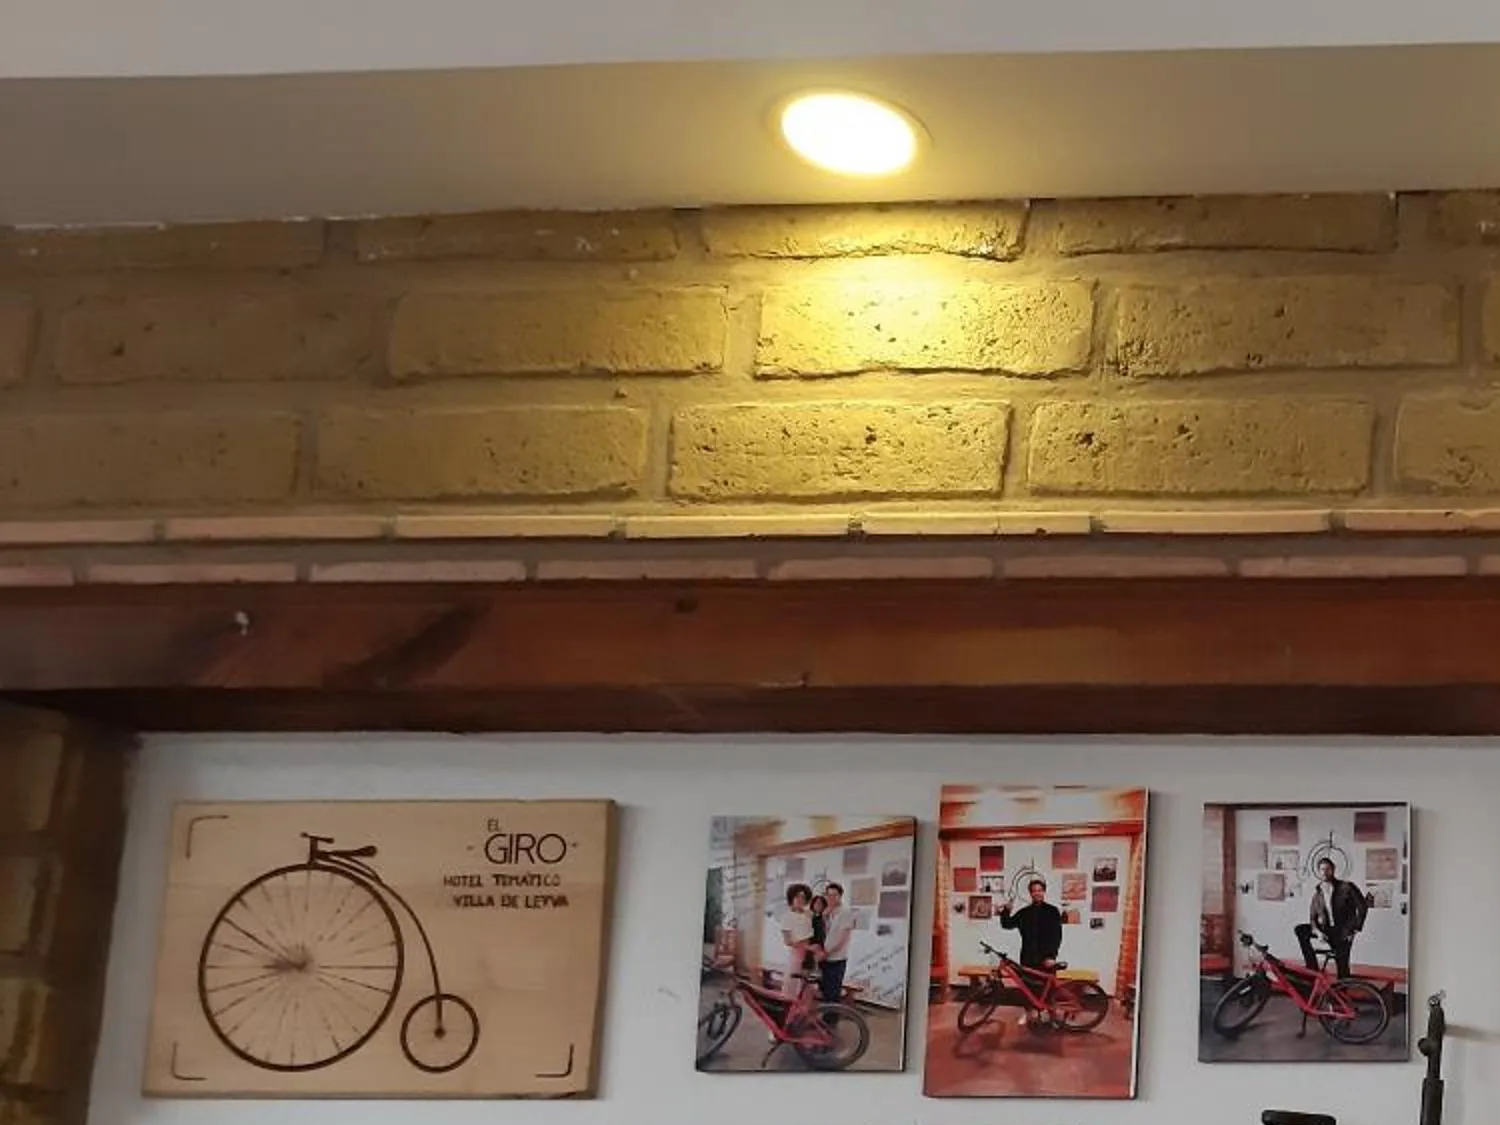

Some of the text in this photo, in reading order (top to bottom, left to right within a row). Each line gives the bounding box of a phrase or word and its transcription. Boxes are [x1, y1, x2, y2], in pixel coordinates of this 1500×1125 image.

[484, 832, 567, 865] GIRO
[443, 873, 483, 887] HOTEL
[452, 894, 569, 909] VILLA DE LEYVA
